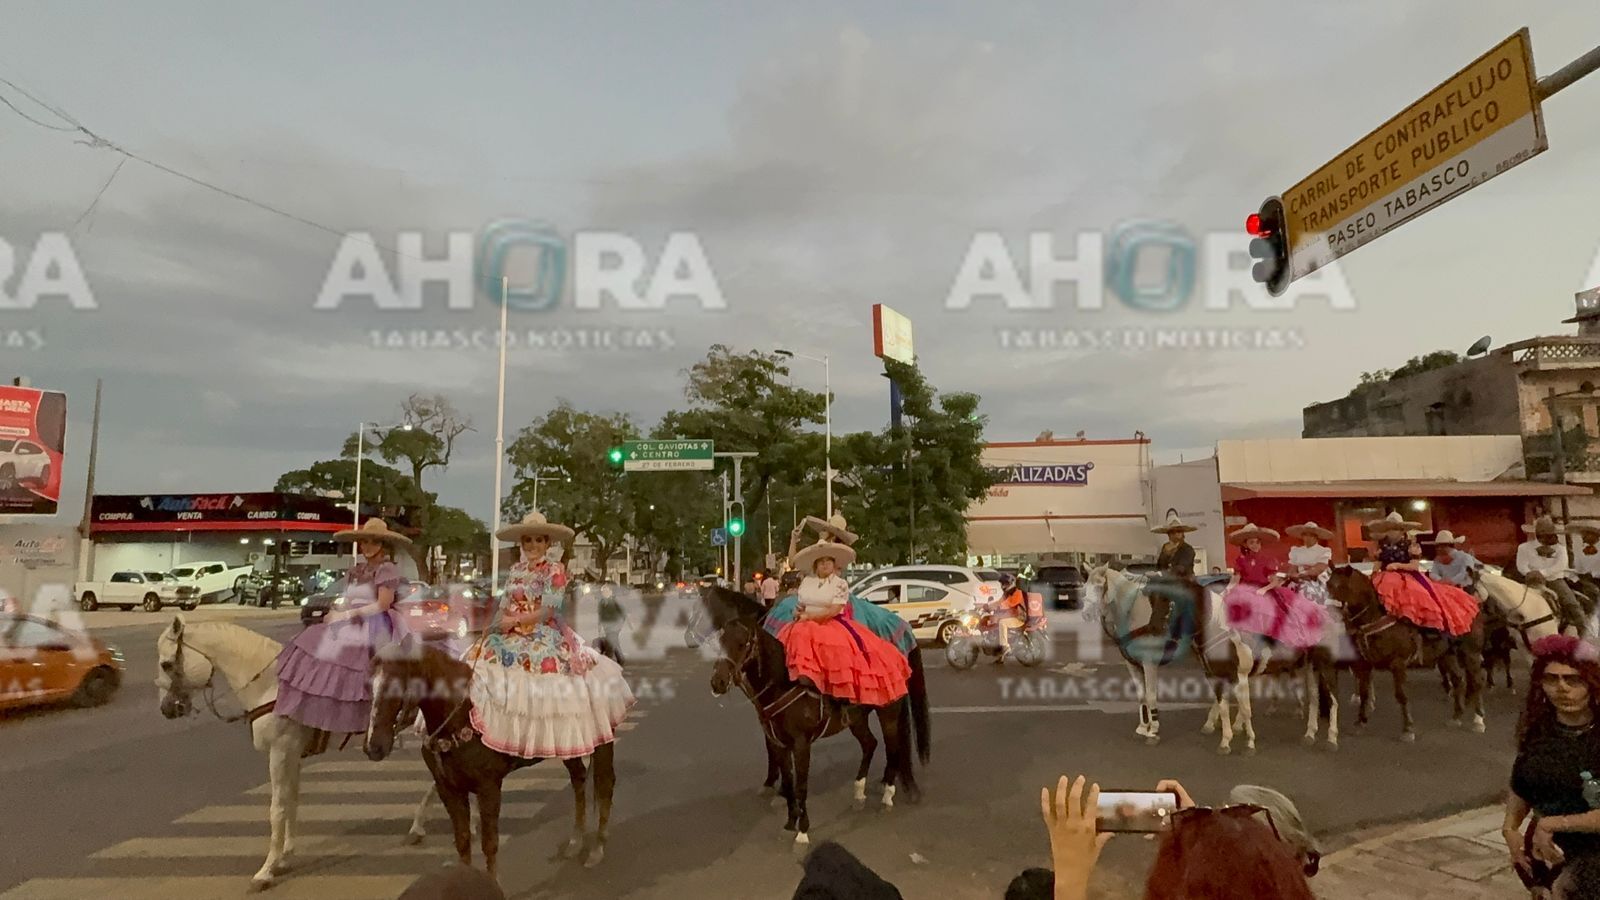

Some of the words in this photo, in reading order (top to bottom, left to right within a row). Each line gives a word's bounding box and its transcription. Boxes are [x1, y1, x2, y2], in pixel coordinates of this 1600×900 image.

[1290, 175, 1339, 215] CARRIL
[1346, 153, 1365, 181] DE
[1373, 57, 1513, 160] CONTRAFLUJO
[1301, 161, 1402, 233] TRANSPORTE
[1411, 100, 1500, 168] PUBLICO
[1327, 212, 1376, 250] PASEO
[1384, 159, 1471, 218] TABASCO
[658, 442, 698, 450] GAVIOTAS
[99, 512, 133, 521] COMPRA
[177, 511, 202, 520] VENTA
[247, 510, 277, 519] CAMBIO
[297, 511, 320, 520] COMPRA
